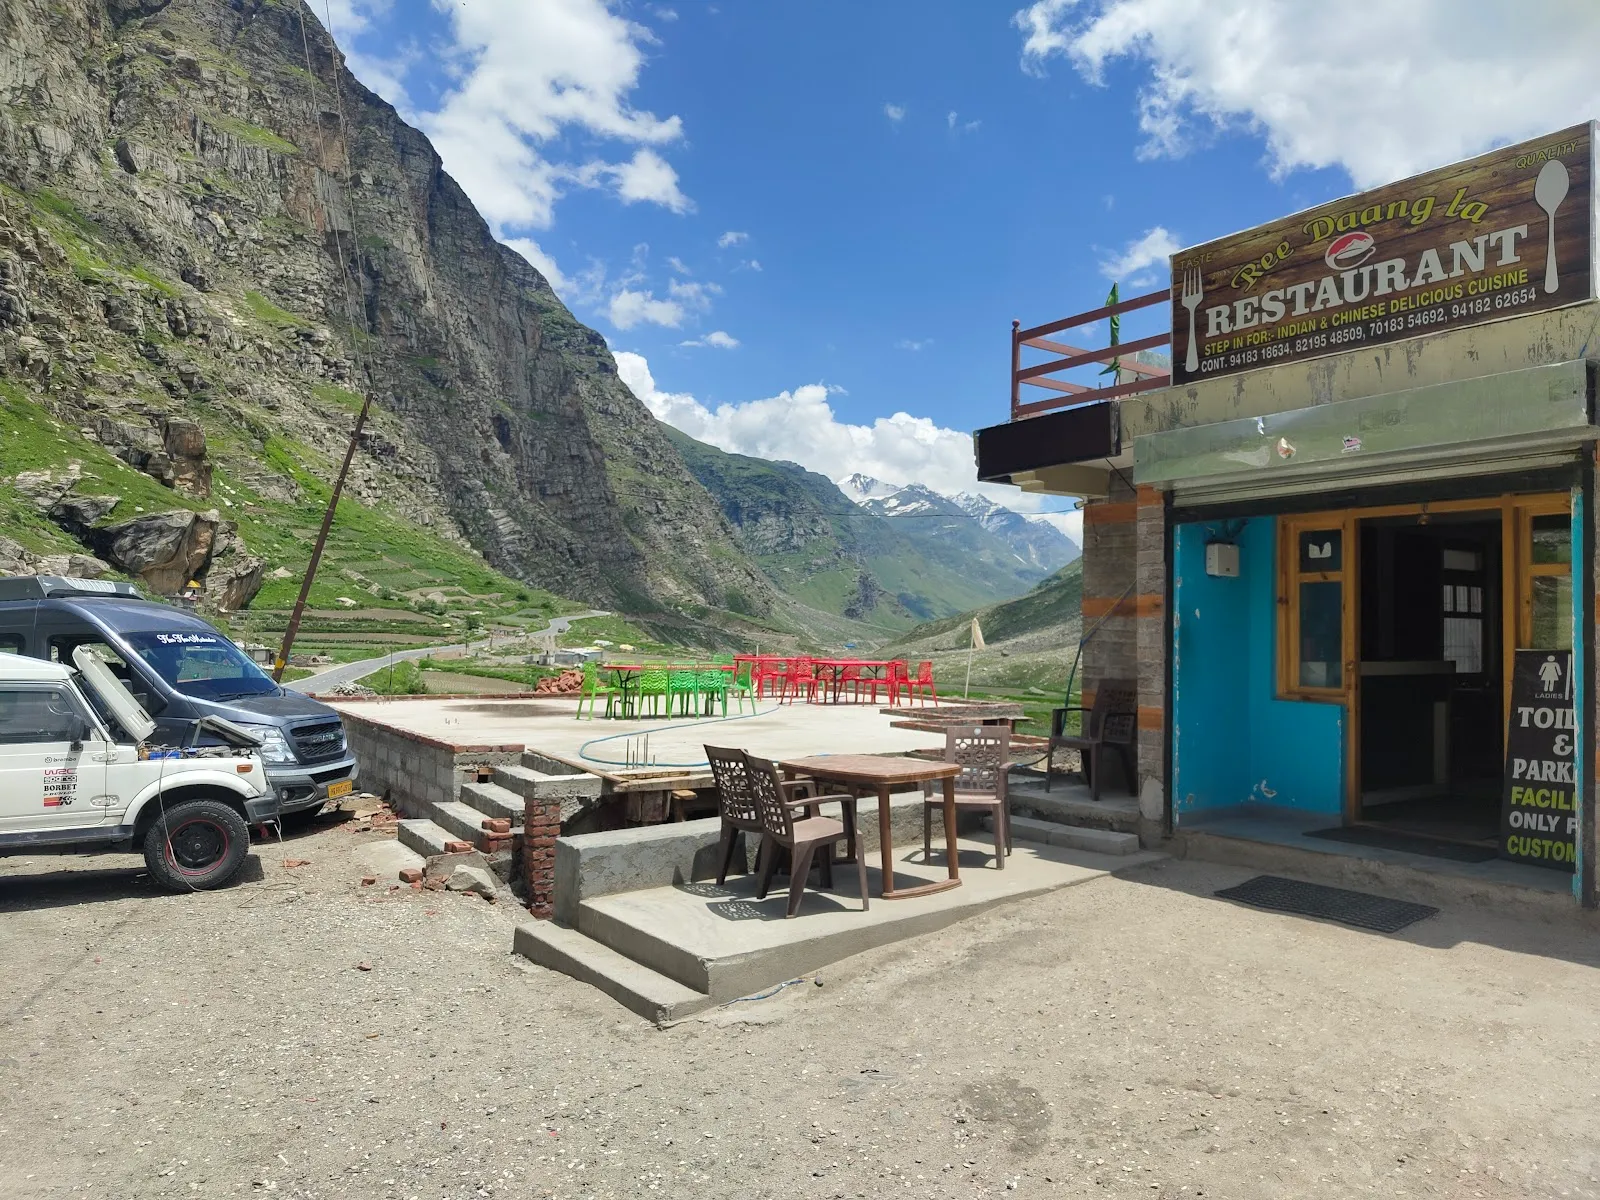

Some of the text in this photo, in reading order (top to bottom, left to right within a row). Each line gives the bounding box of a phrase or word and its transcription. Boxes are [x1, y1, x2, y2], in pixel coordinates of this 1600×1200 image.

[1515, 140, 1578, 169] QUALITY
[1230, 239, 1295, 293] Ree
[1302, 196, 1436, 243] Daang
[1179, 253, 1213, 271] TASTE
[1205, 224, 1528, 338] RESTAURANT
[1204, 339, 1229, 356] STEP
[1233, 336, 1244, 349] IN
[1277, 320, 1316, 338] INDIAN
[1320, 316, 1328, 328] &
[1331, 300, 1386, 327] CHINESE
[1390, 283, 1463, 314] DELICIOUS
[1468, 268, 1529, 294] CUISINE
[1201, 287, 1536, 373] CONT. 94183 18634, 82195 48509, 70183 54692, 94182 62654
[1517, 706, 1574, 729] TOIL
[1553, 734, 1573, 756] &
[1512, 758, 1575, 784] PARK
[1510, 786, 1576, 811] FACILI
[1509, 811, 1560, 832] ONLY
[1507, 835, 1576, 863] CUSTOM
